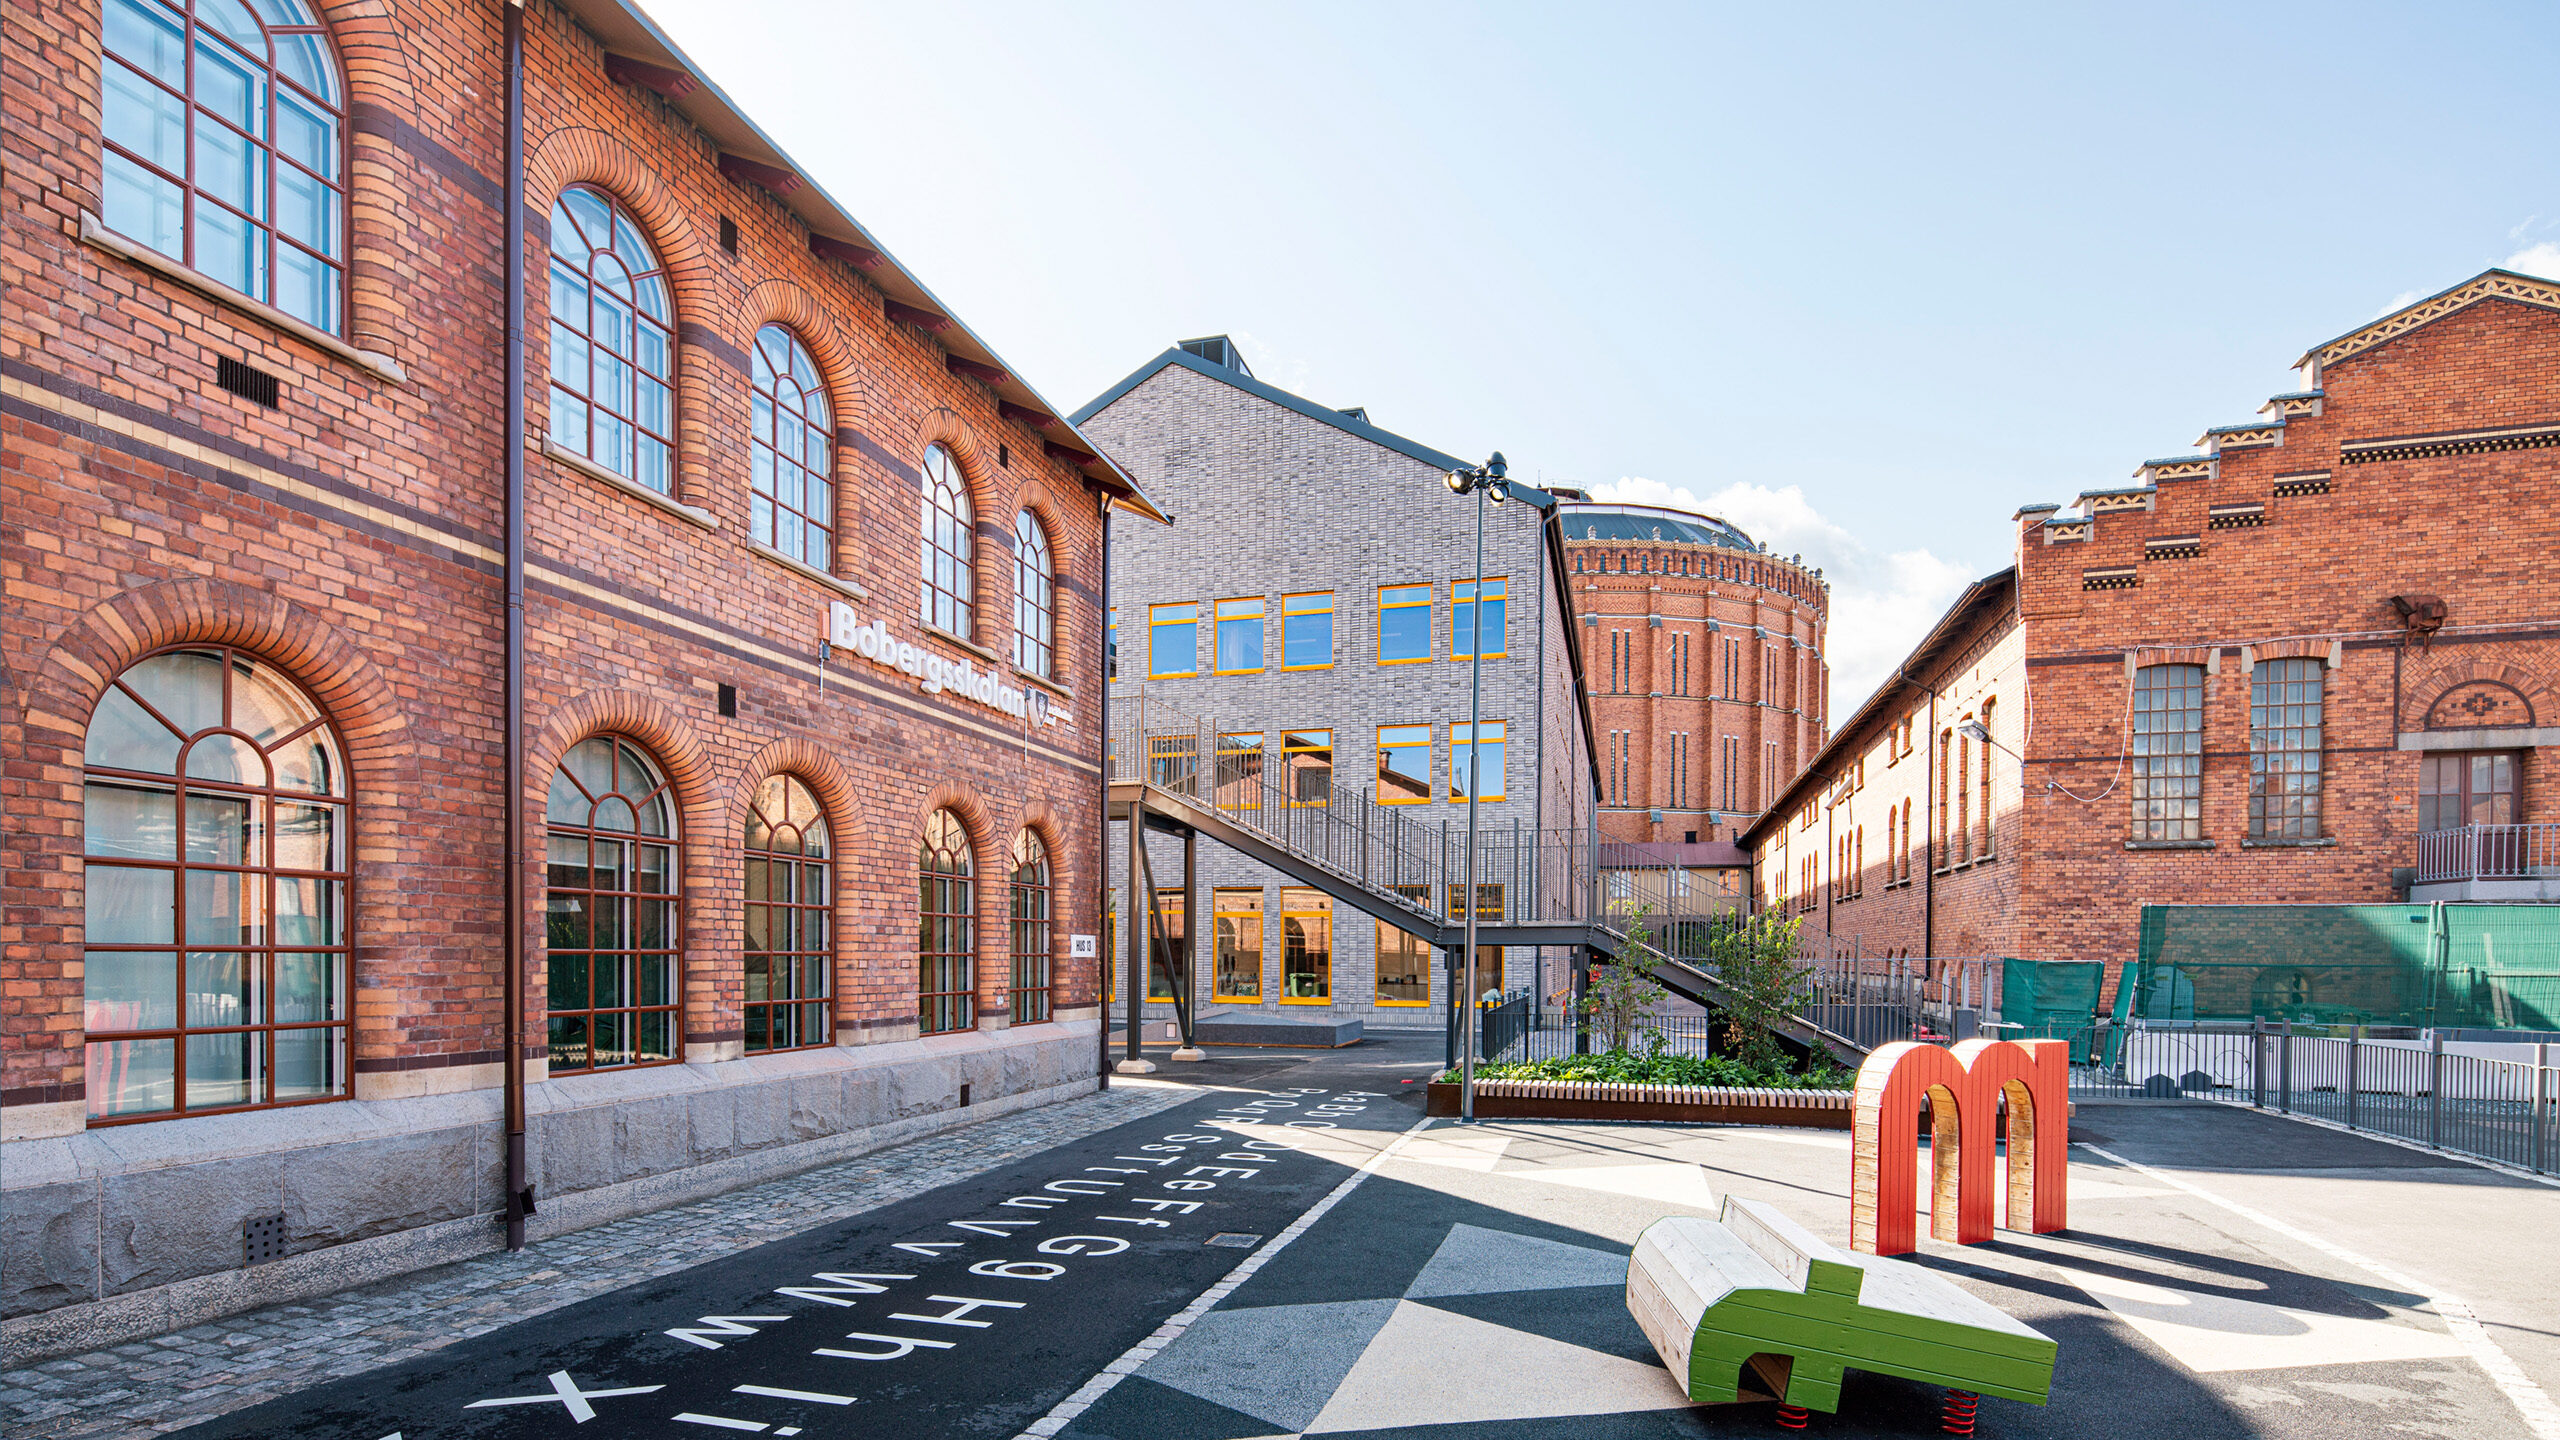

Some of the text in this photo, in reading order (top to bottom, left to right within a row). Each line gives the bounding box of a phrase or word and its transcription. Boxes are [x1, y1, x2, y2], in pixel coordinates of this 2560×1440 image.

[830, 600, 1026, 718] Bobergsskolan
[1075, 940, 1092, 952] HUS 13
